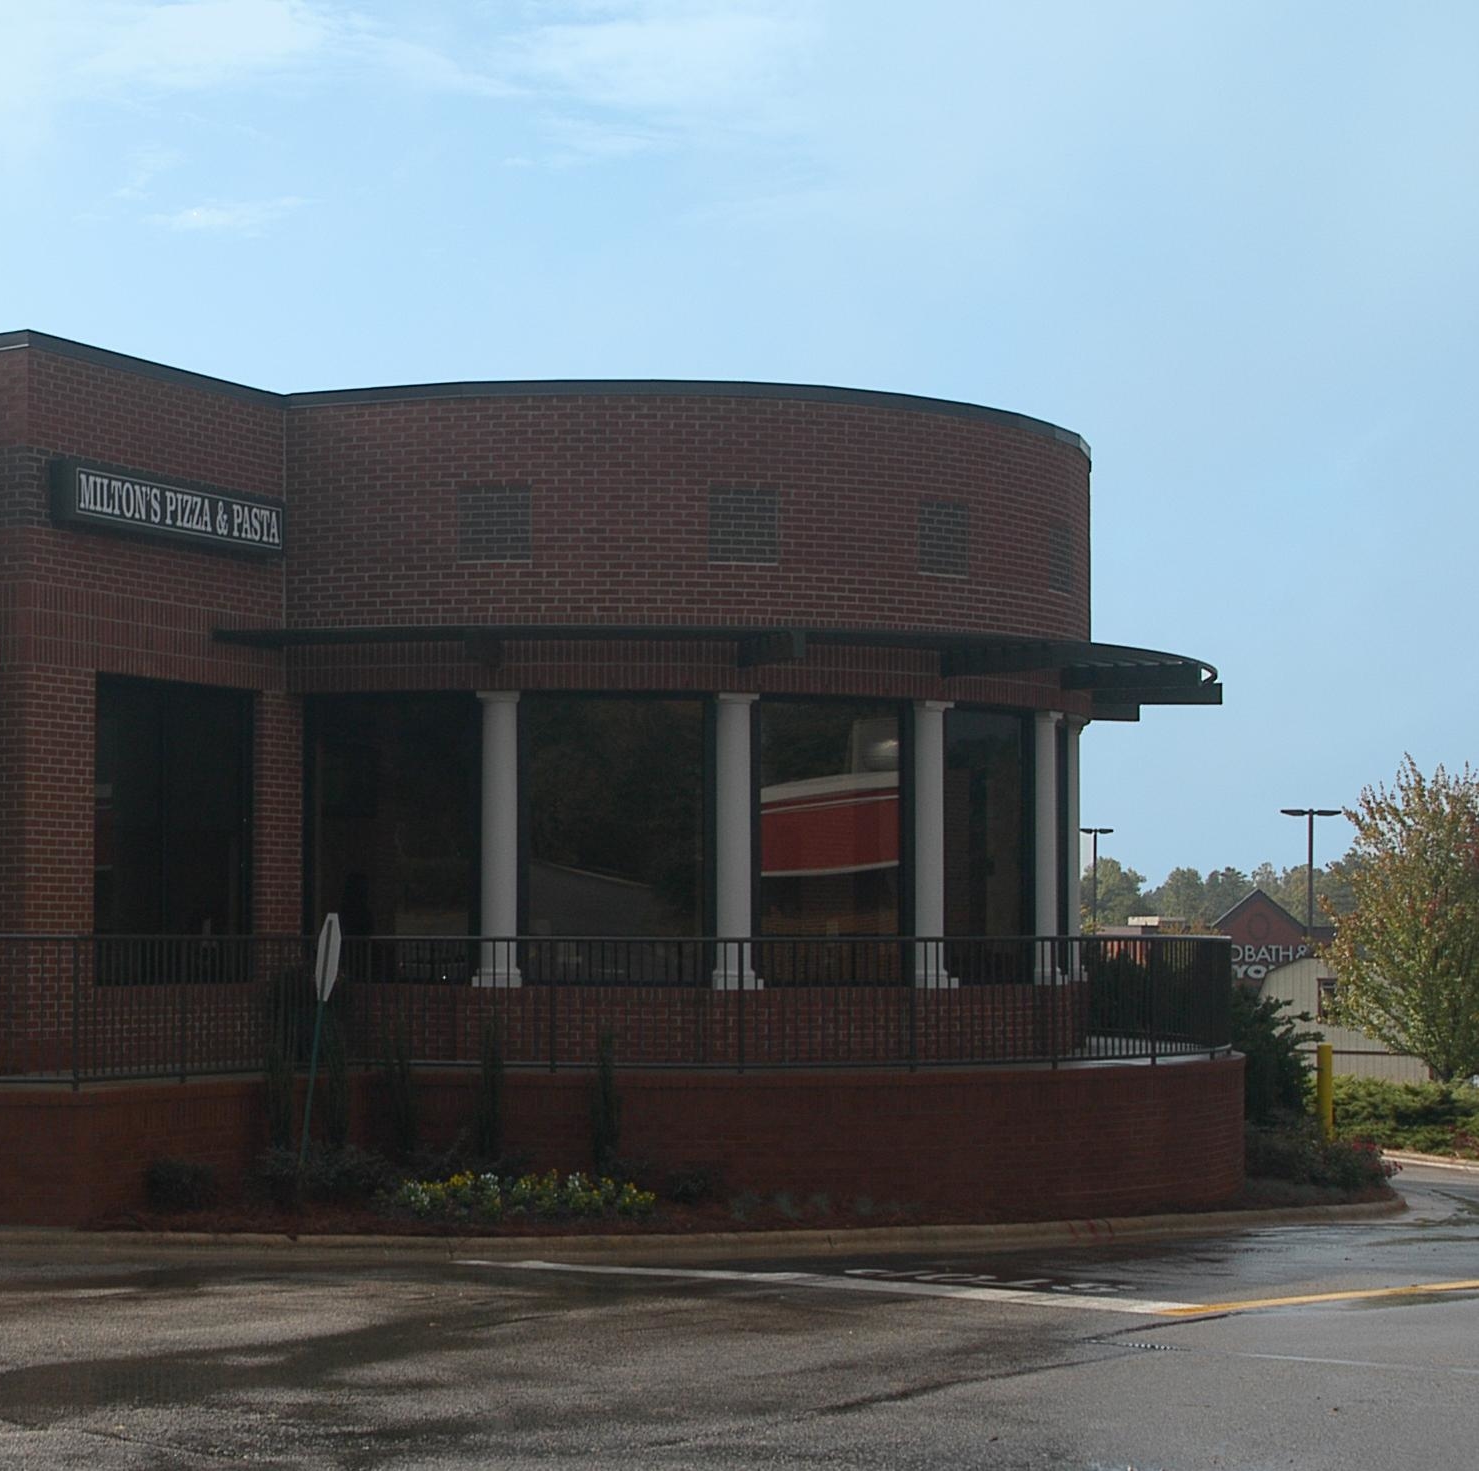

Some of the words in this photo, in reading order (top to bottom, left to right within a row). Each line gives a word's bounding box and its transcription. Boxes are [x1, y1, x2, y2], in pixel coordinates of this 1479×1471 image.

[79, 473, 161, 524] MILTON'S
[165, 490, 212, 532] PIZZA
[216, 501, 229, 536] &
[232, 503, 280, 544] PASTA
